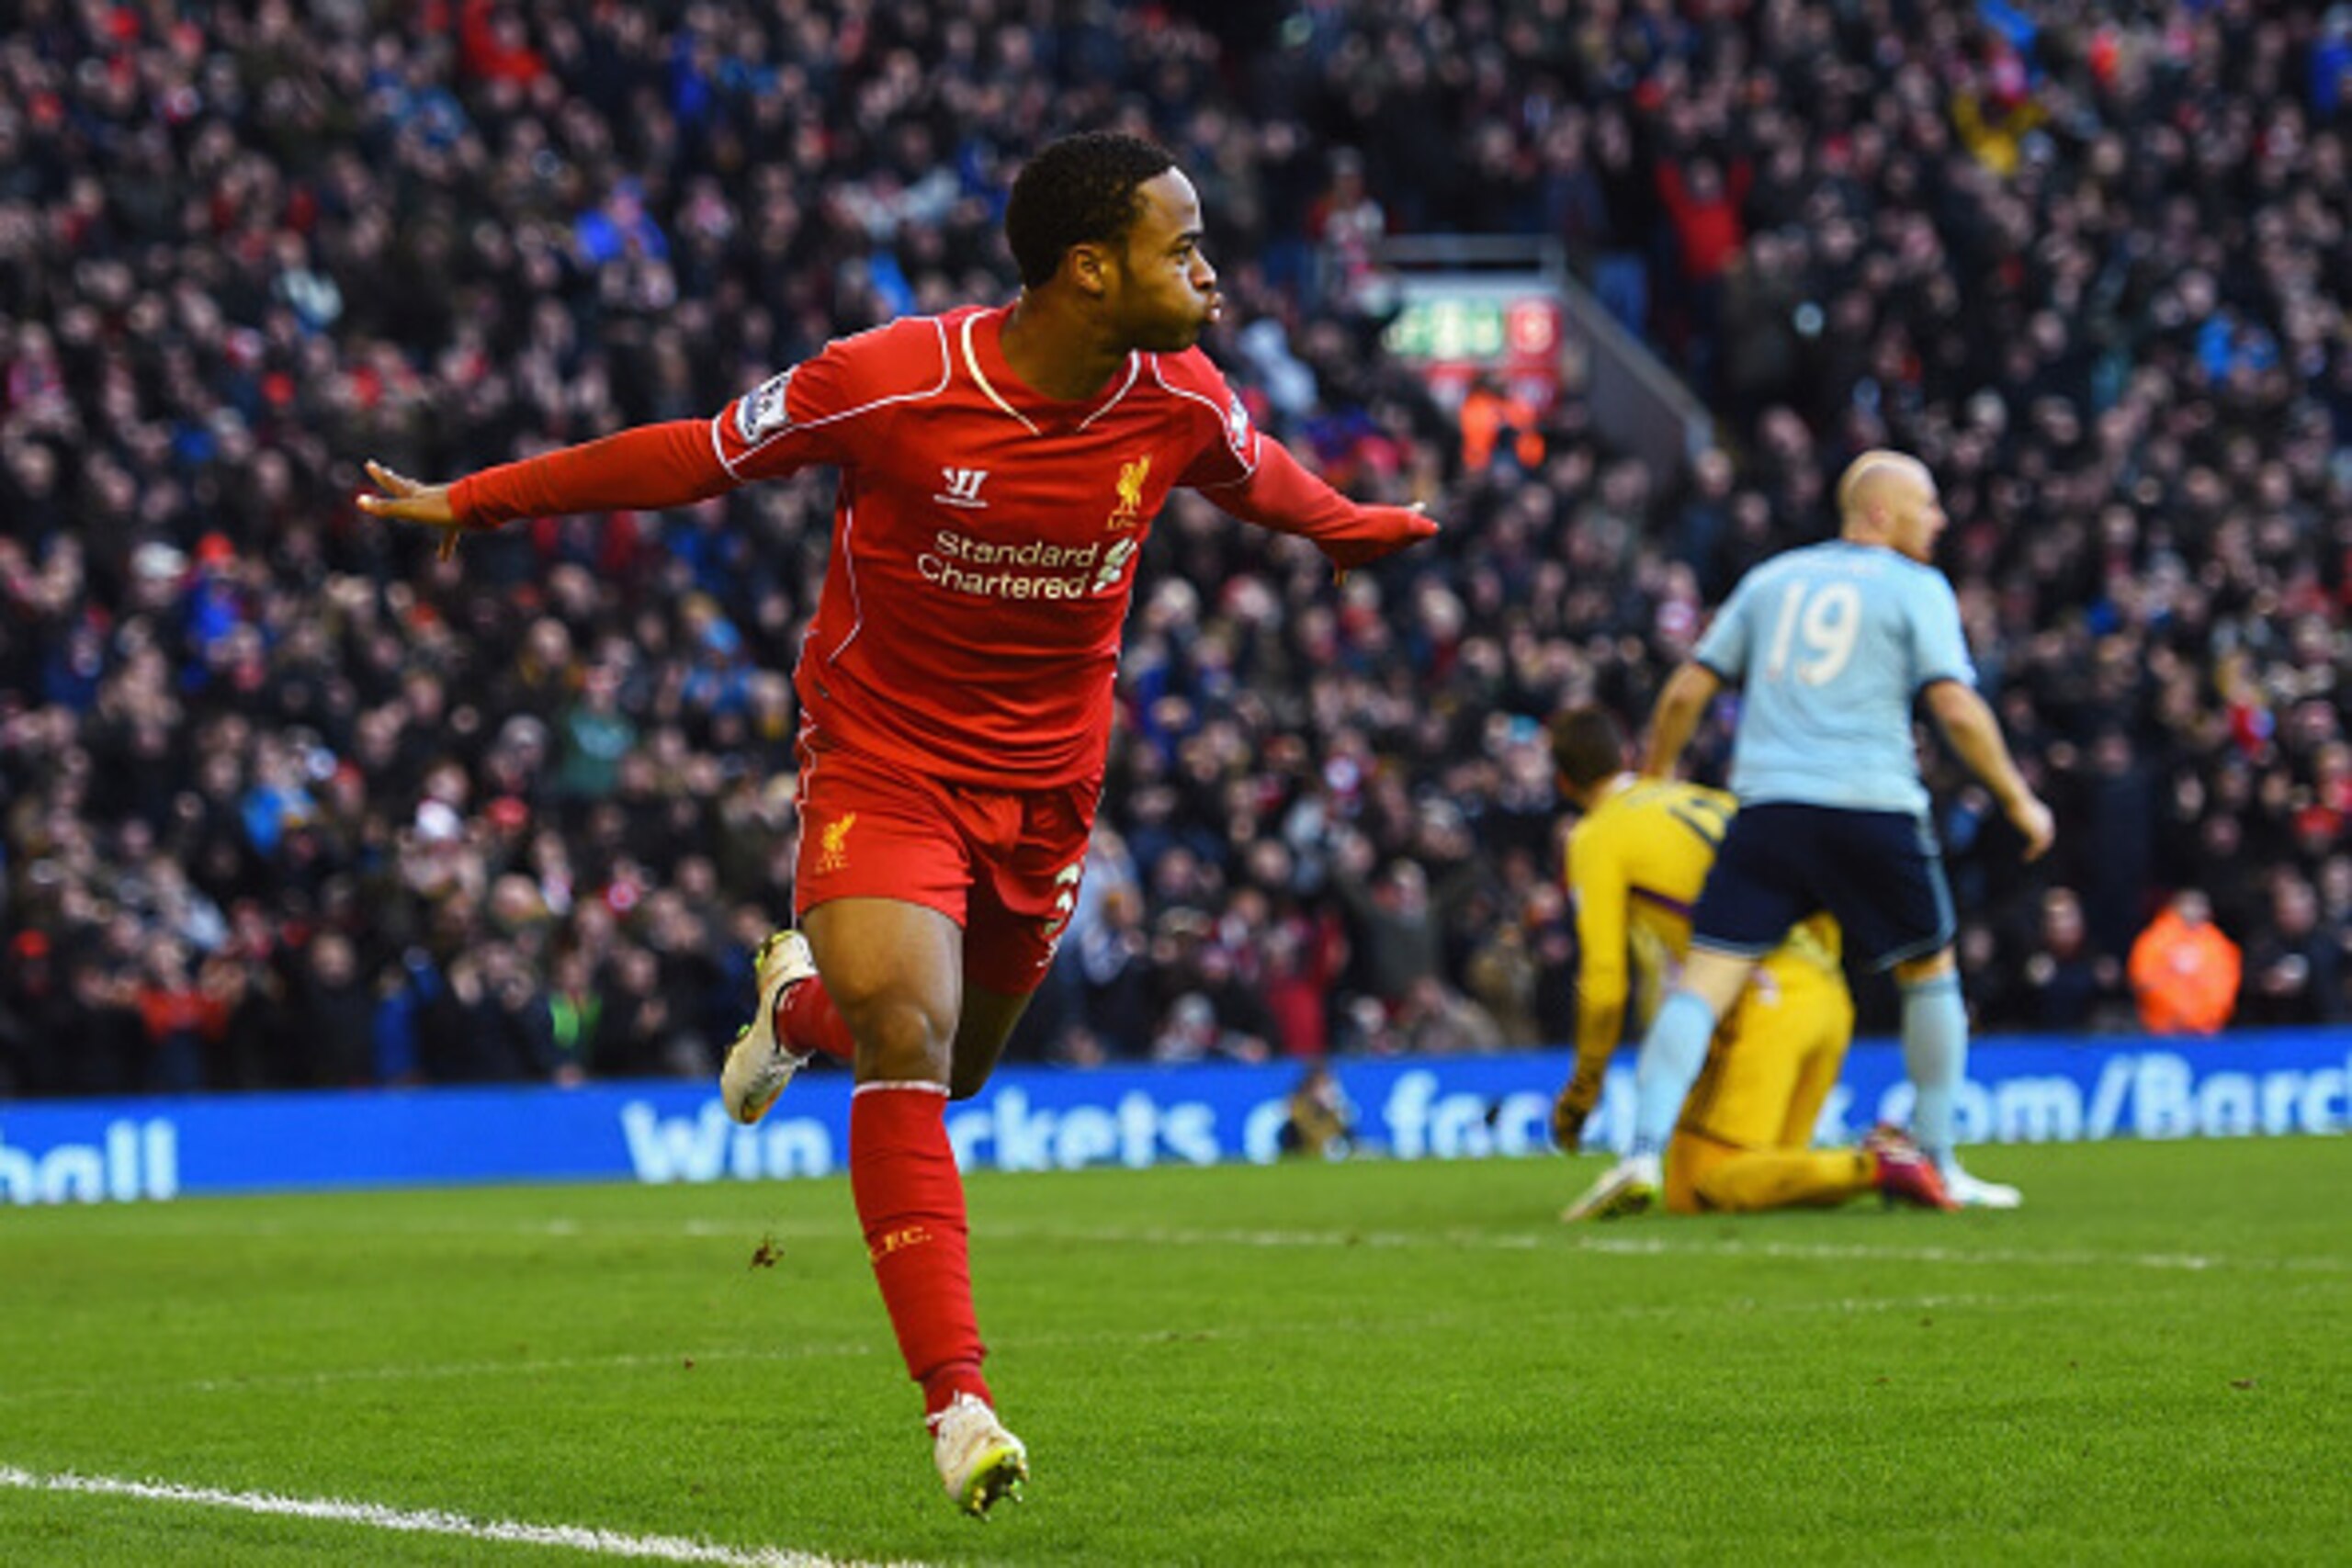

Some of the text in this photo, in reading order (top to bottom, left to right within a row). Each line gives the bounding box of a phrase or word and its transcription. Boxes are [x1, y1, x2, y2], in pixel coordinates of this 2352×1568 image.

[917, 553, 1091, 598] Chartered
[934, 530, 1100, 569] Standard
[1766, 579, 1862, 687] 19
[621, 1099, 832, 1183] Win
